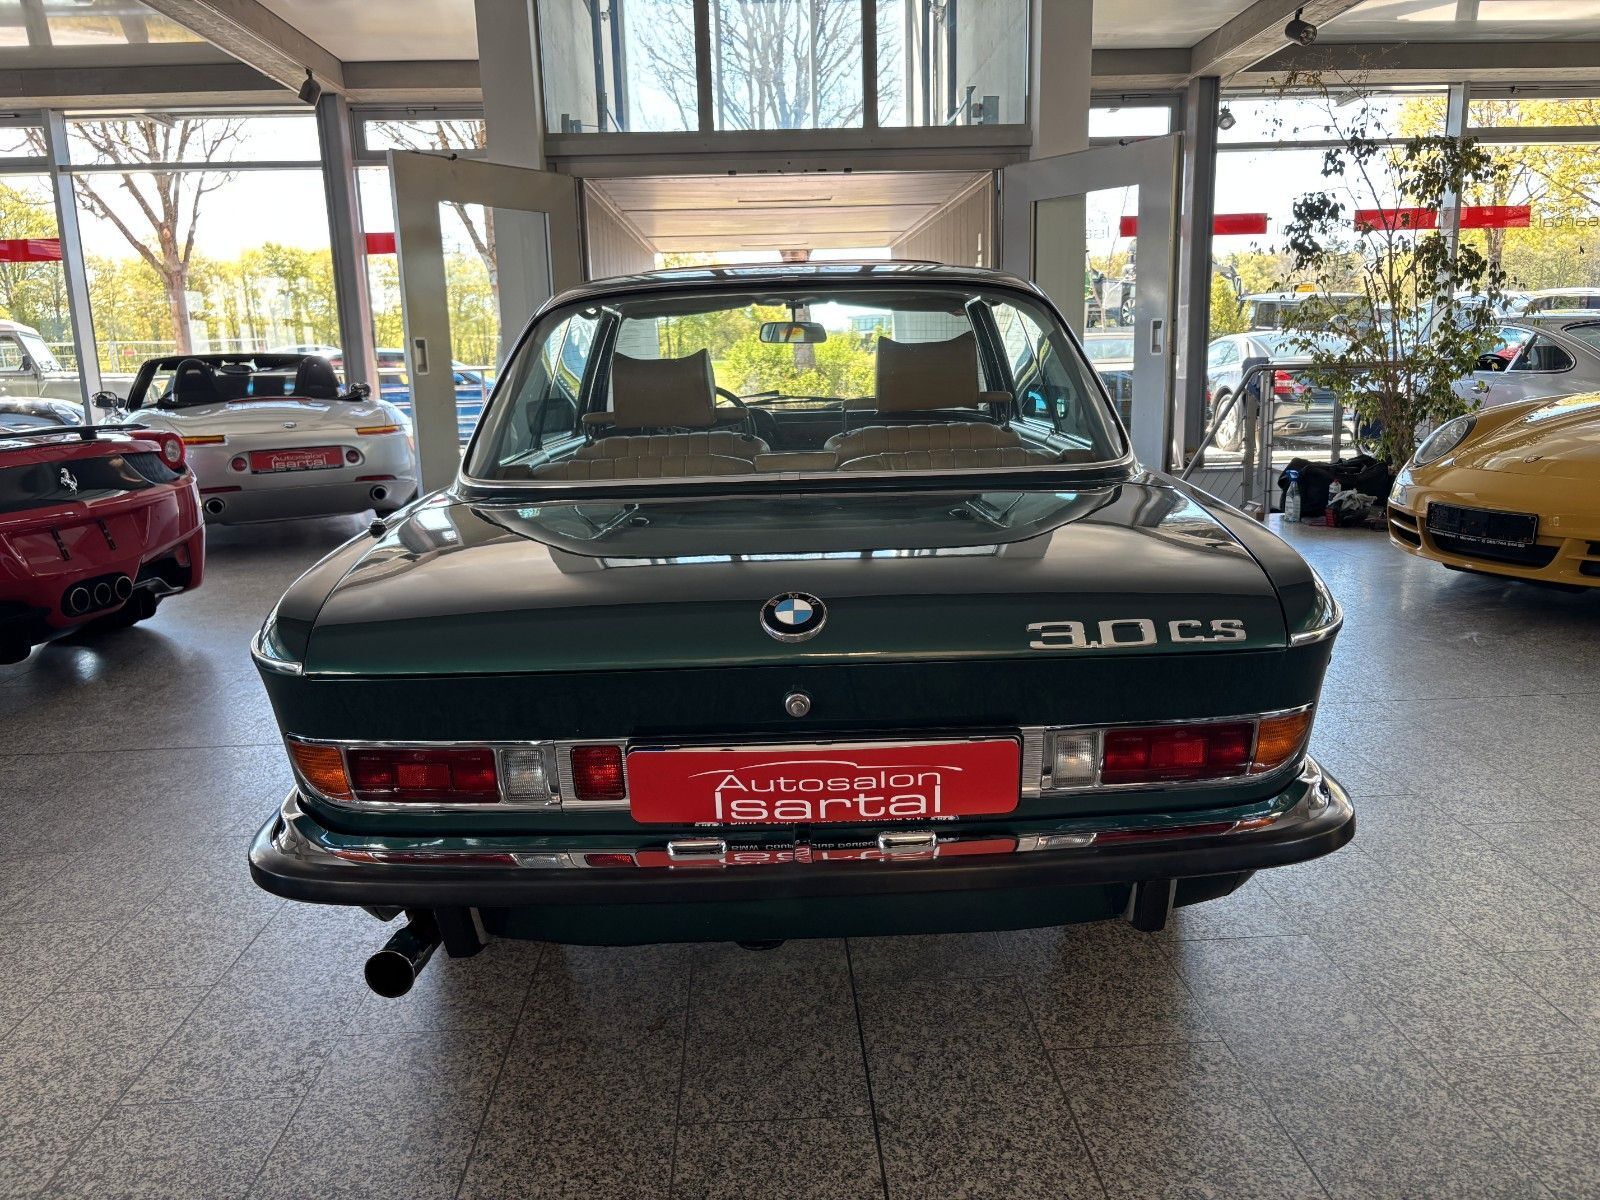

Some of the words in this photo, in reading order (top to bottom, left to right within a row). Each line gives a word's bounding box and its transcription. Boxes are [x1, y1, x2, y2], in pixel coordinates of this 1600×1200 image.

[769, 593, 820, 606] BMW
[1026, 618, 1158, 650] 3.0
[714, 770, 942, 793] Autosalon
[713, 784, 942, 820] Isartal
